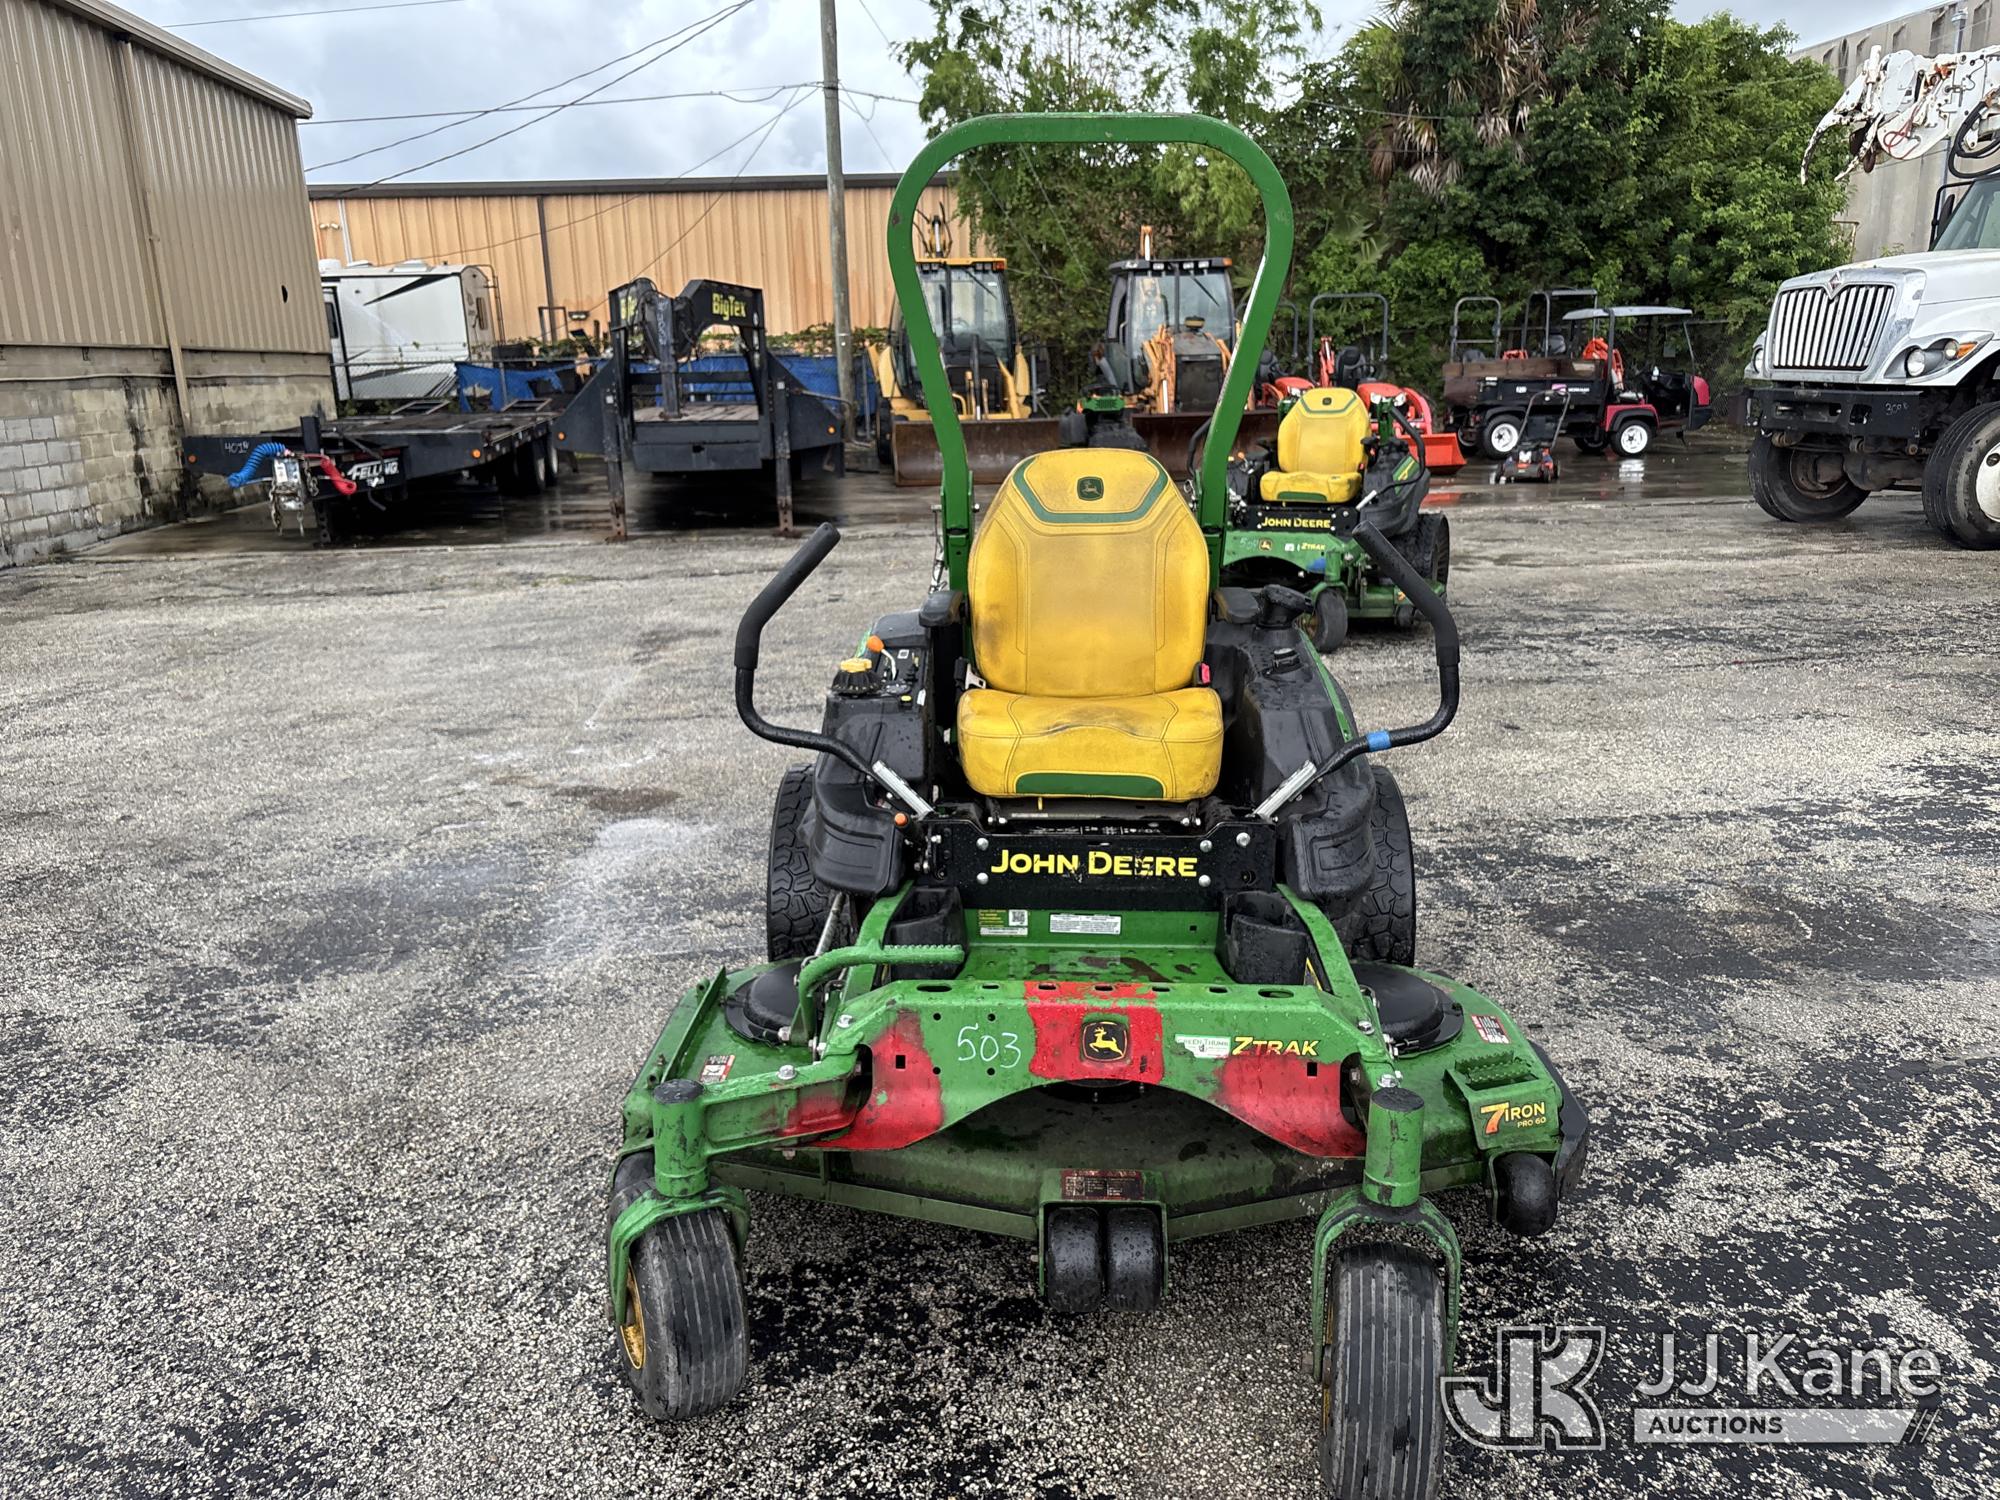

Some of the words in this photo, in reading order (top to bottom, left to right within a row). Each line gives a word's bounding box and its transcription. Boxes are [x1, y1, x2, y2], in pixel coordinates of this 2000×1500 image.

[1261, 516, 1291, 527] JOHN
[1293, 517, 1331, 528] DEERE
[1301, 542, 1326, 551] ZTRAK
[990, 849, 1079, 875] JOHN
[1087, 850, 1198, 877] DEERE
[957, 1022, 1022, 1069] 503
[1231, 1036, 1320, 1056] ZTRAK
[1517, 1119, 1534, 1129] PRO
[1535, 1116, 1547, 1125] 60
